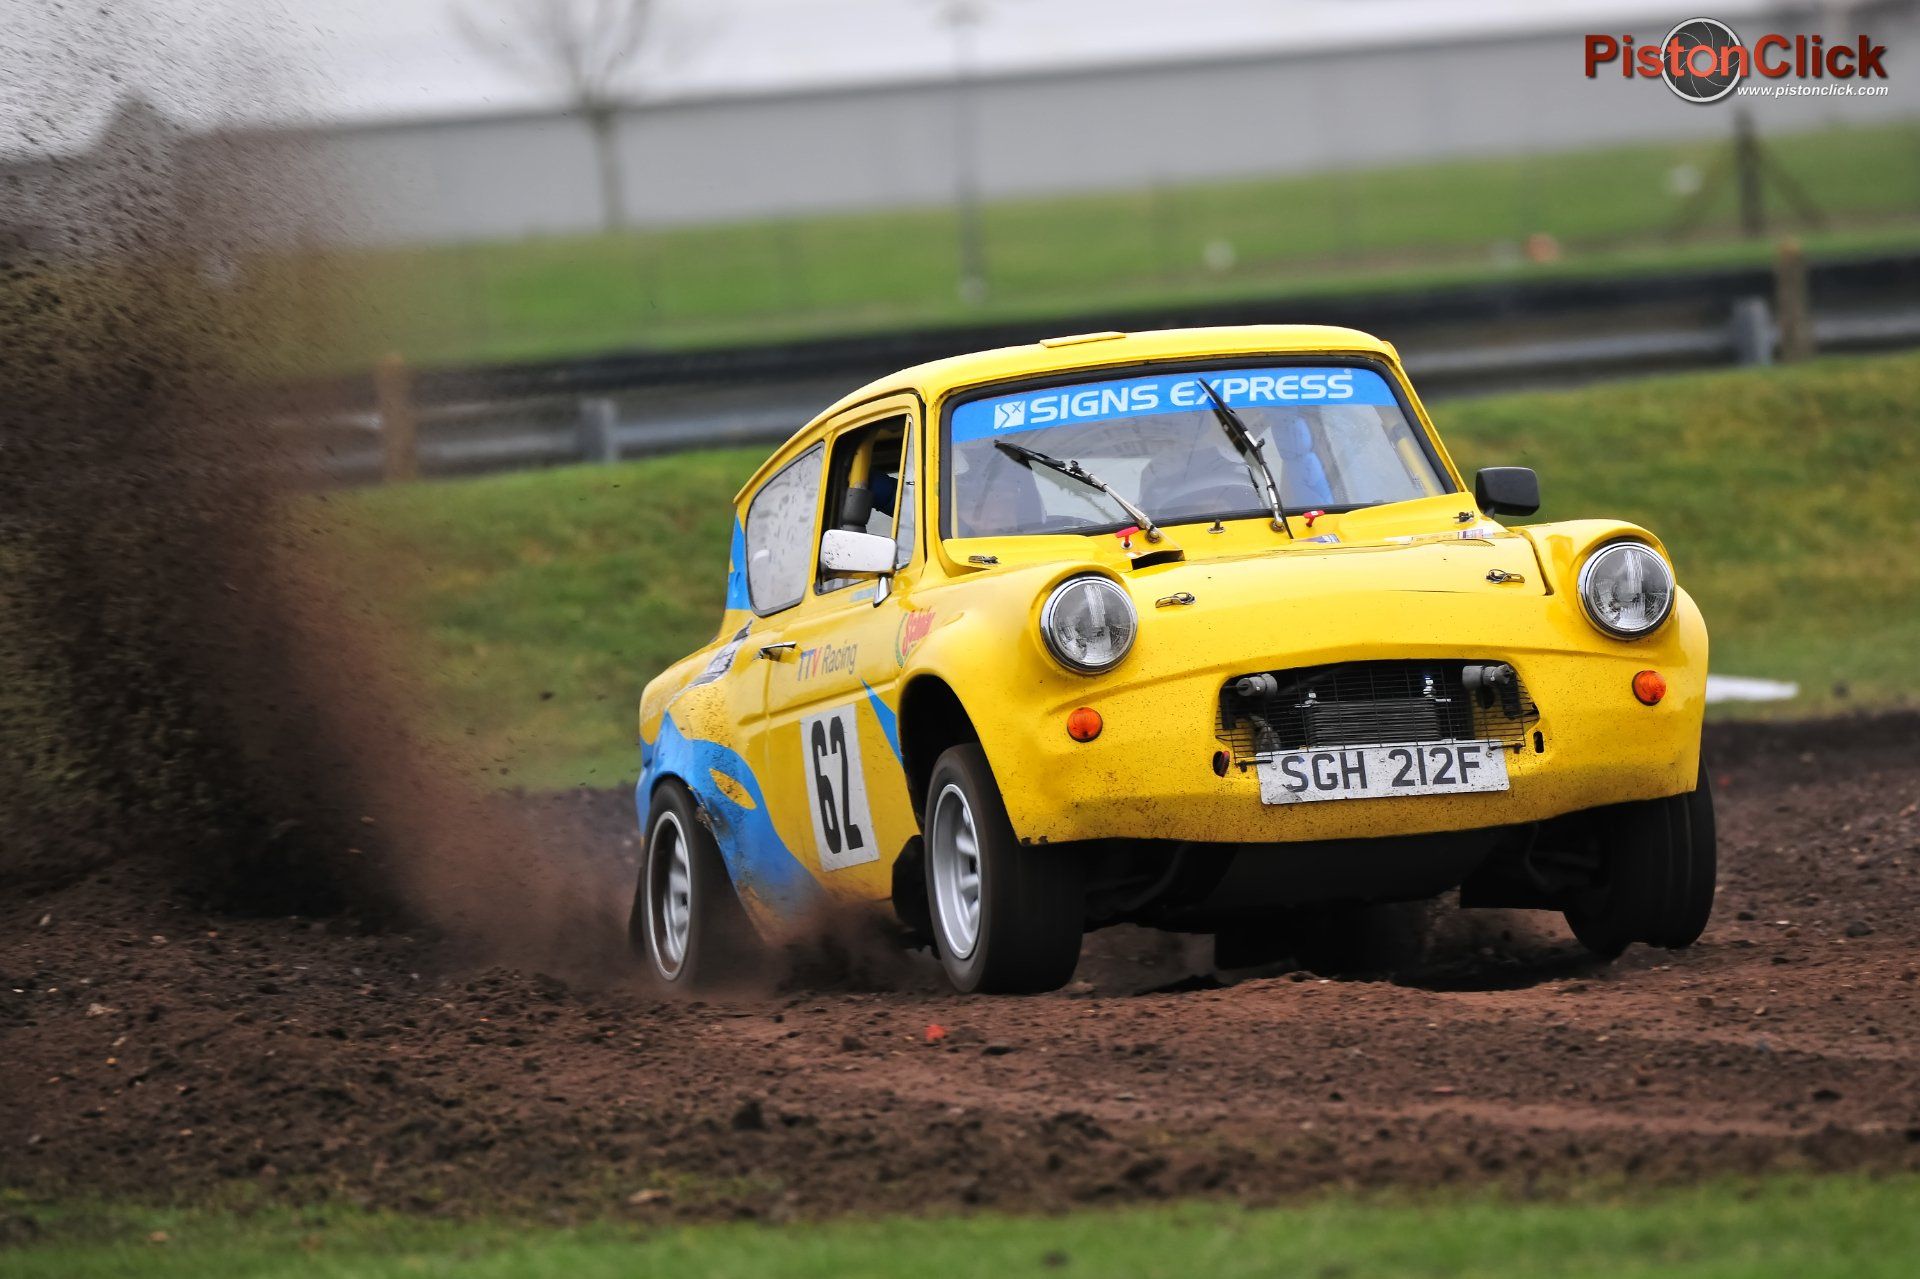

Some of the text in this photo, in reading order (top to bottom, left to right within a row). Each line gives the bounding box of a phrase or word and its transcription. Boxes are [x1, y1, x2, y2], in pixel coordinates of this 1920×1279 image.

[1030, 374, 1354, 424] SIGNS EXPRESS
[821, 639, 858, 676] Racing
[811, 716, 864, 855] 62
[1281, 746, 1481, 793] SGH 212F
